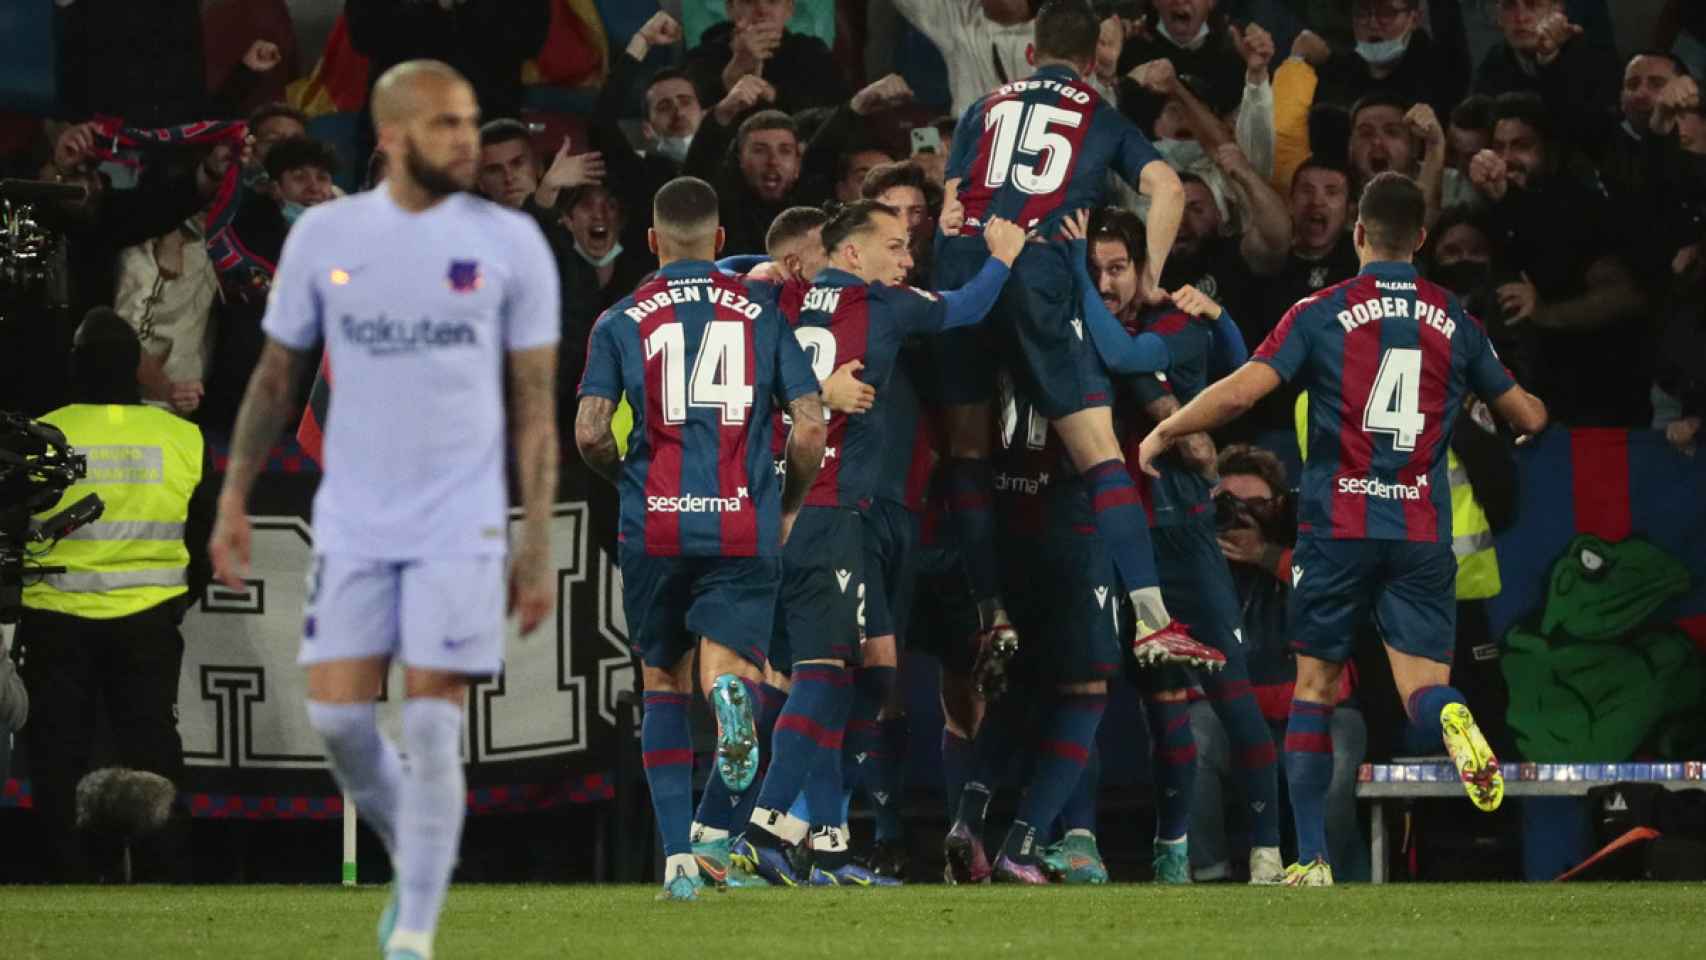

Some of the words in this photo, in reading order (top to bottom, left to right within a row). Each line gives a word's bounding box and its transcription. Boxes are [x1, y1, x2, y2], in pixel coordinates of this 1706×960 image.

[999, 80, 1091, 106] POSTIGO
[985, 99, 1085, 195] 15
[624, 285, 701, 323] RUBEN
[705, 286, 763, 321] VEZO
[800, 291, 841, 314] SON
[1337, 297, 1411, 334] ROBER
[1413, 299, 1458, 340] PIER
[645, 320, 755, 426] 14
[1361, 347, 1426, 453] 4
[647, 494, 742, 513] sesderma
[1337, 476, 1421, 500] sesderma
